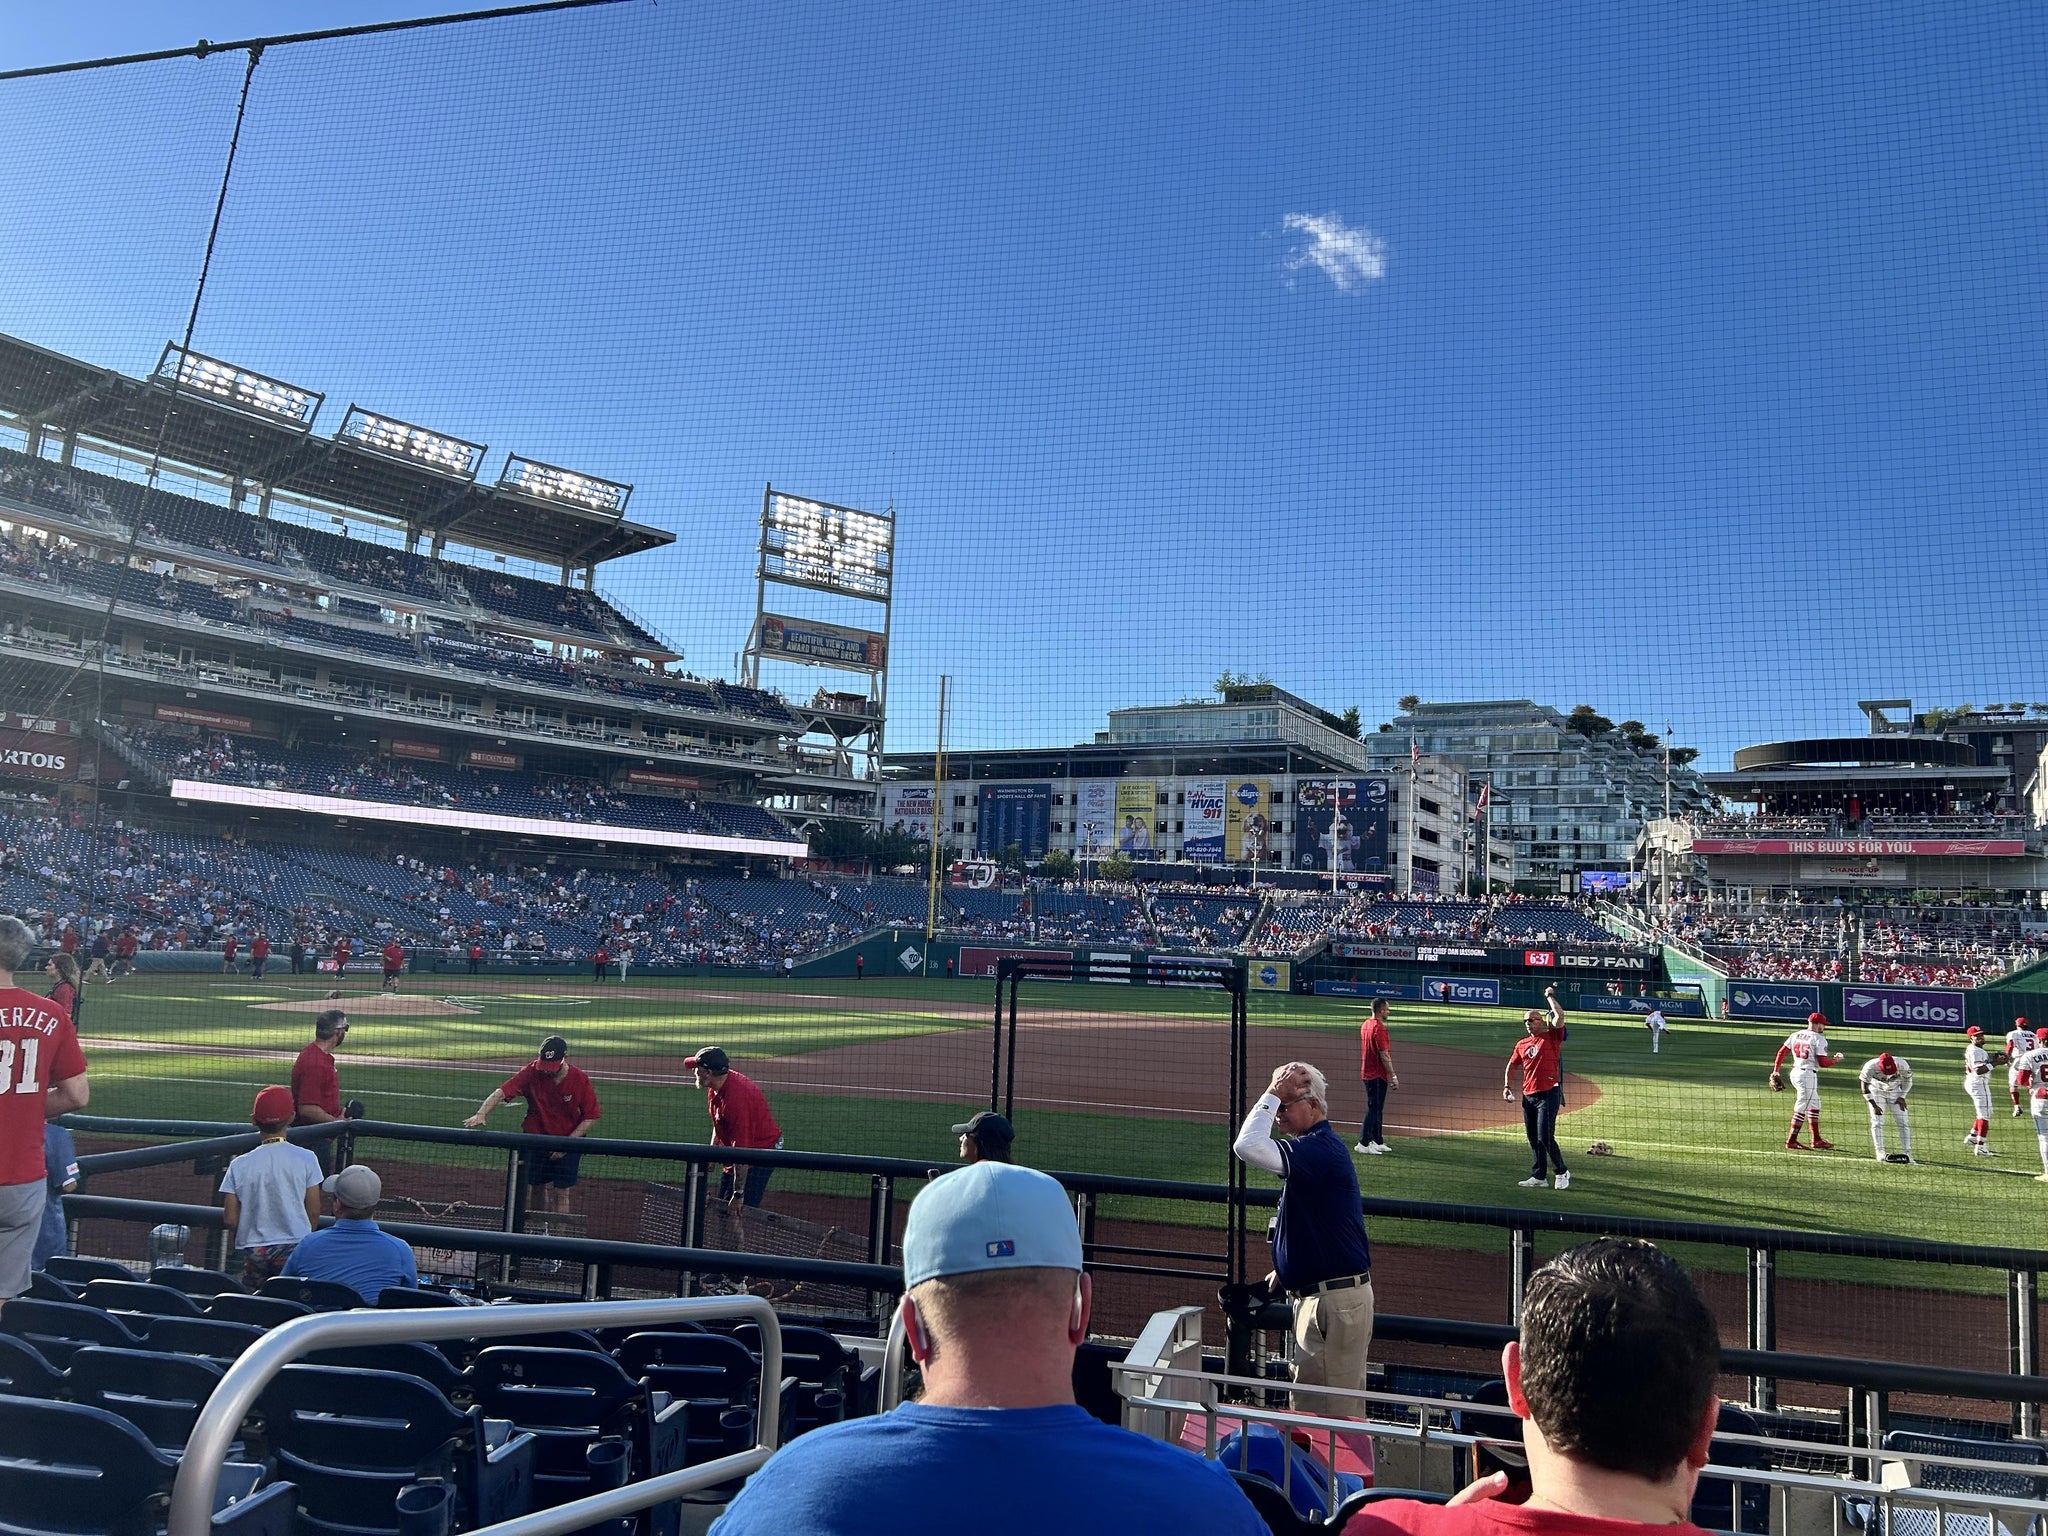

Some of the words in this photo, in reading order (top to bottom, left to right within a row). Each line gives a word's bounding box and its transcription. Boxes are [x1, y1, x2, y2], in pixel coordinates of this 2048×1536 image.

[790, 633, 825, 647] BEAUTIFUL
[825, 638, 846, 650] VIEWS
[846, 642, 860, 652] AND
[786, 641, 810, 654] AWARD
[811, 644, 840, 658] WINNING
[840, 650, 863, 662] BREWS
[21, 718, 57, 731] NATTUDE
[0, 750, 66, 770] RTOIS
[1232, 789, 1264, 799] Pedigree
[1190, 798, 1224, 809] HVAC
[1203, 808, 1222, 819] 911
[1788, 841, 1816, 853] THIS
[1818, 841, 1856, 853] BUD'S
[1858, 841, 1883, 853] FOR
[1885, 841, 1917, 853] YOU.
[1352, 946, 1381, 956] Harris
[1381, 947, 1413, 958] Teeter
[1417, 946, 1433, 954] CREW
[1432, 947, 1447, 955] CHIEF
[1417, 953, 1425, 961] AT
[1424, 954, 1439, 962] FIRST
[1529, 953, 1550, 965] 6:37
[1604, 957, 1644, 969] FAN
[928, 959, 939, 969] 336
[1448, 982, 1494, 999] Terra
[1569, 982, 1581, 993] 377
[1597, 998, 1621, 1006] MGM
[1659, 1000, 1683, 1009] MGM
[1751, 993, 1812, 1007] VANDA
[1881, 998, 1960, 1022] leidos
[0, 1007, 60, 1037] ERZER
[2025, 1038, 2035, 1052] 3
